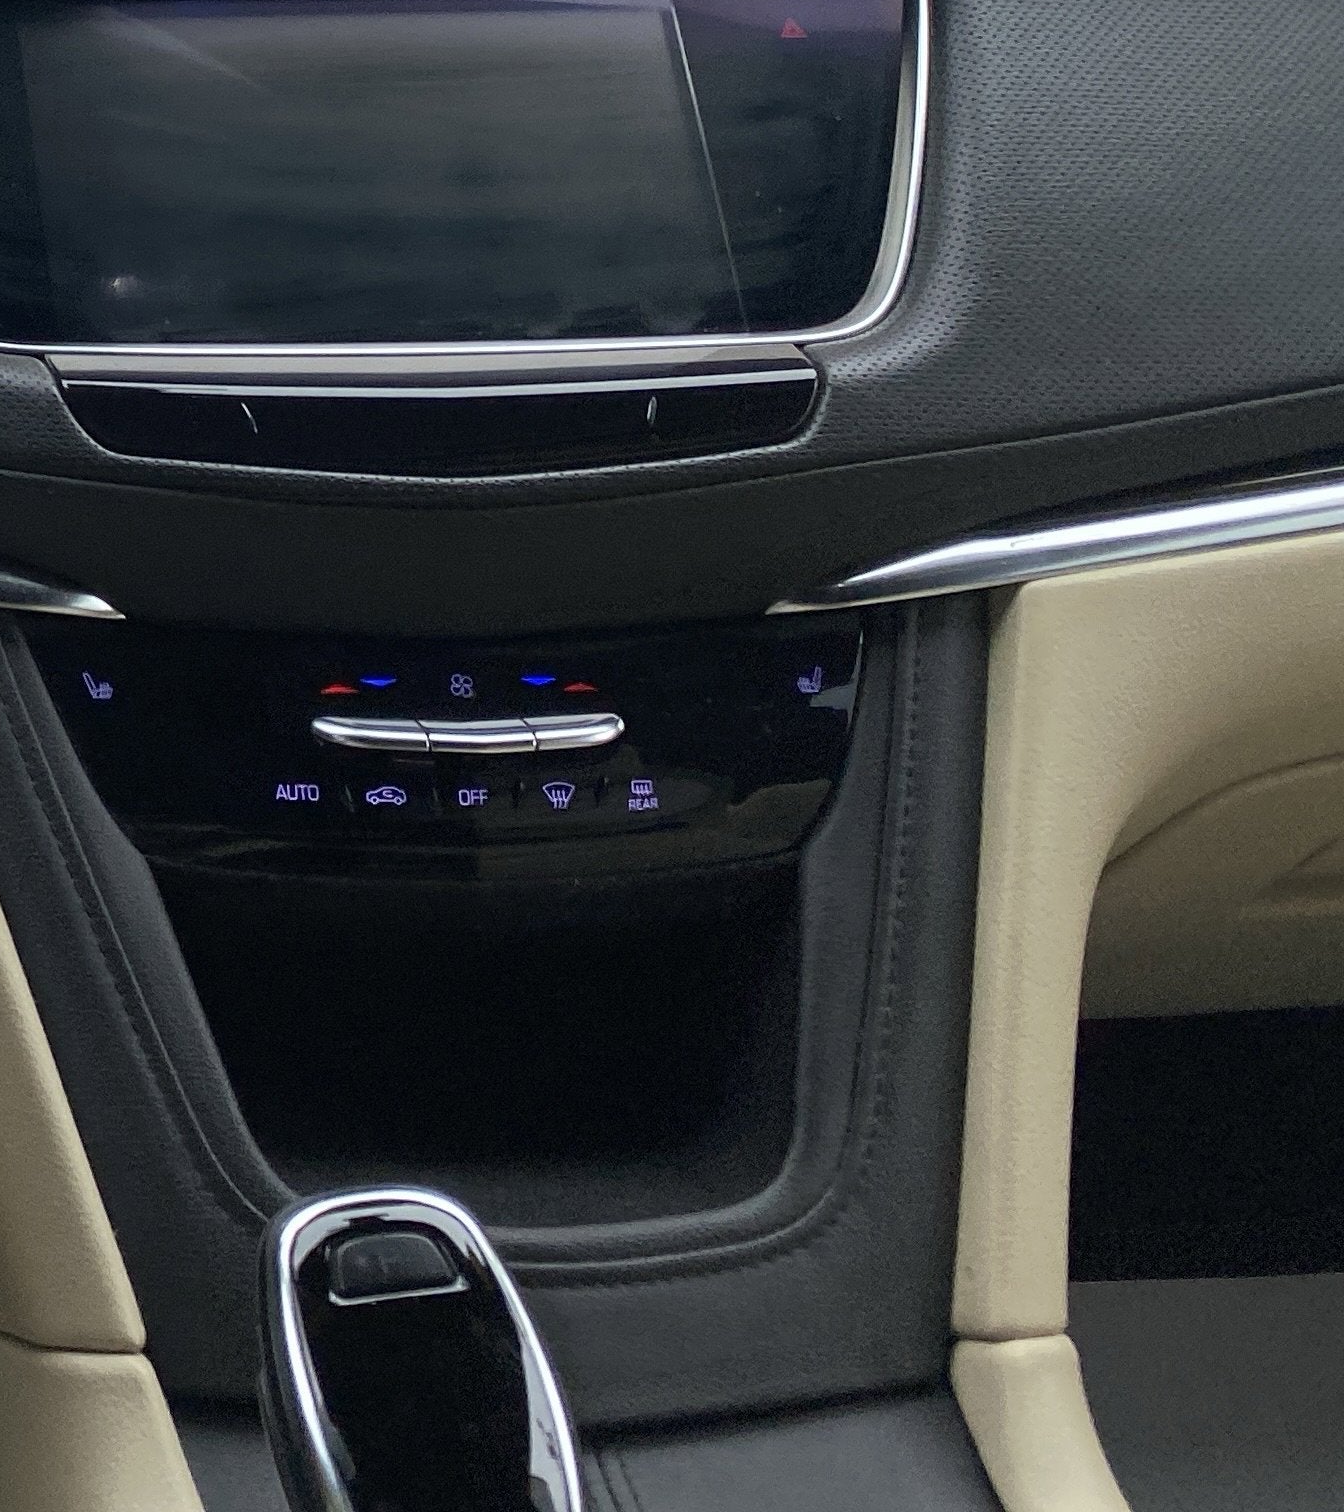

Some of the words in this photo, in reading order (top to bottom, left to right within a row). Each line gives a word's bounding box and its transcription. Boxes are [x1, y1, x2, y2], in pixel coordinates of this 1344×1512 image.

[276, 784, 320, 802] AUTO
[458, 790, 488, 806] OFF
[628, 798, 658, 811] REAR
